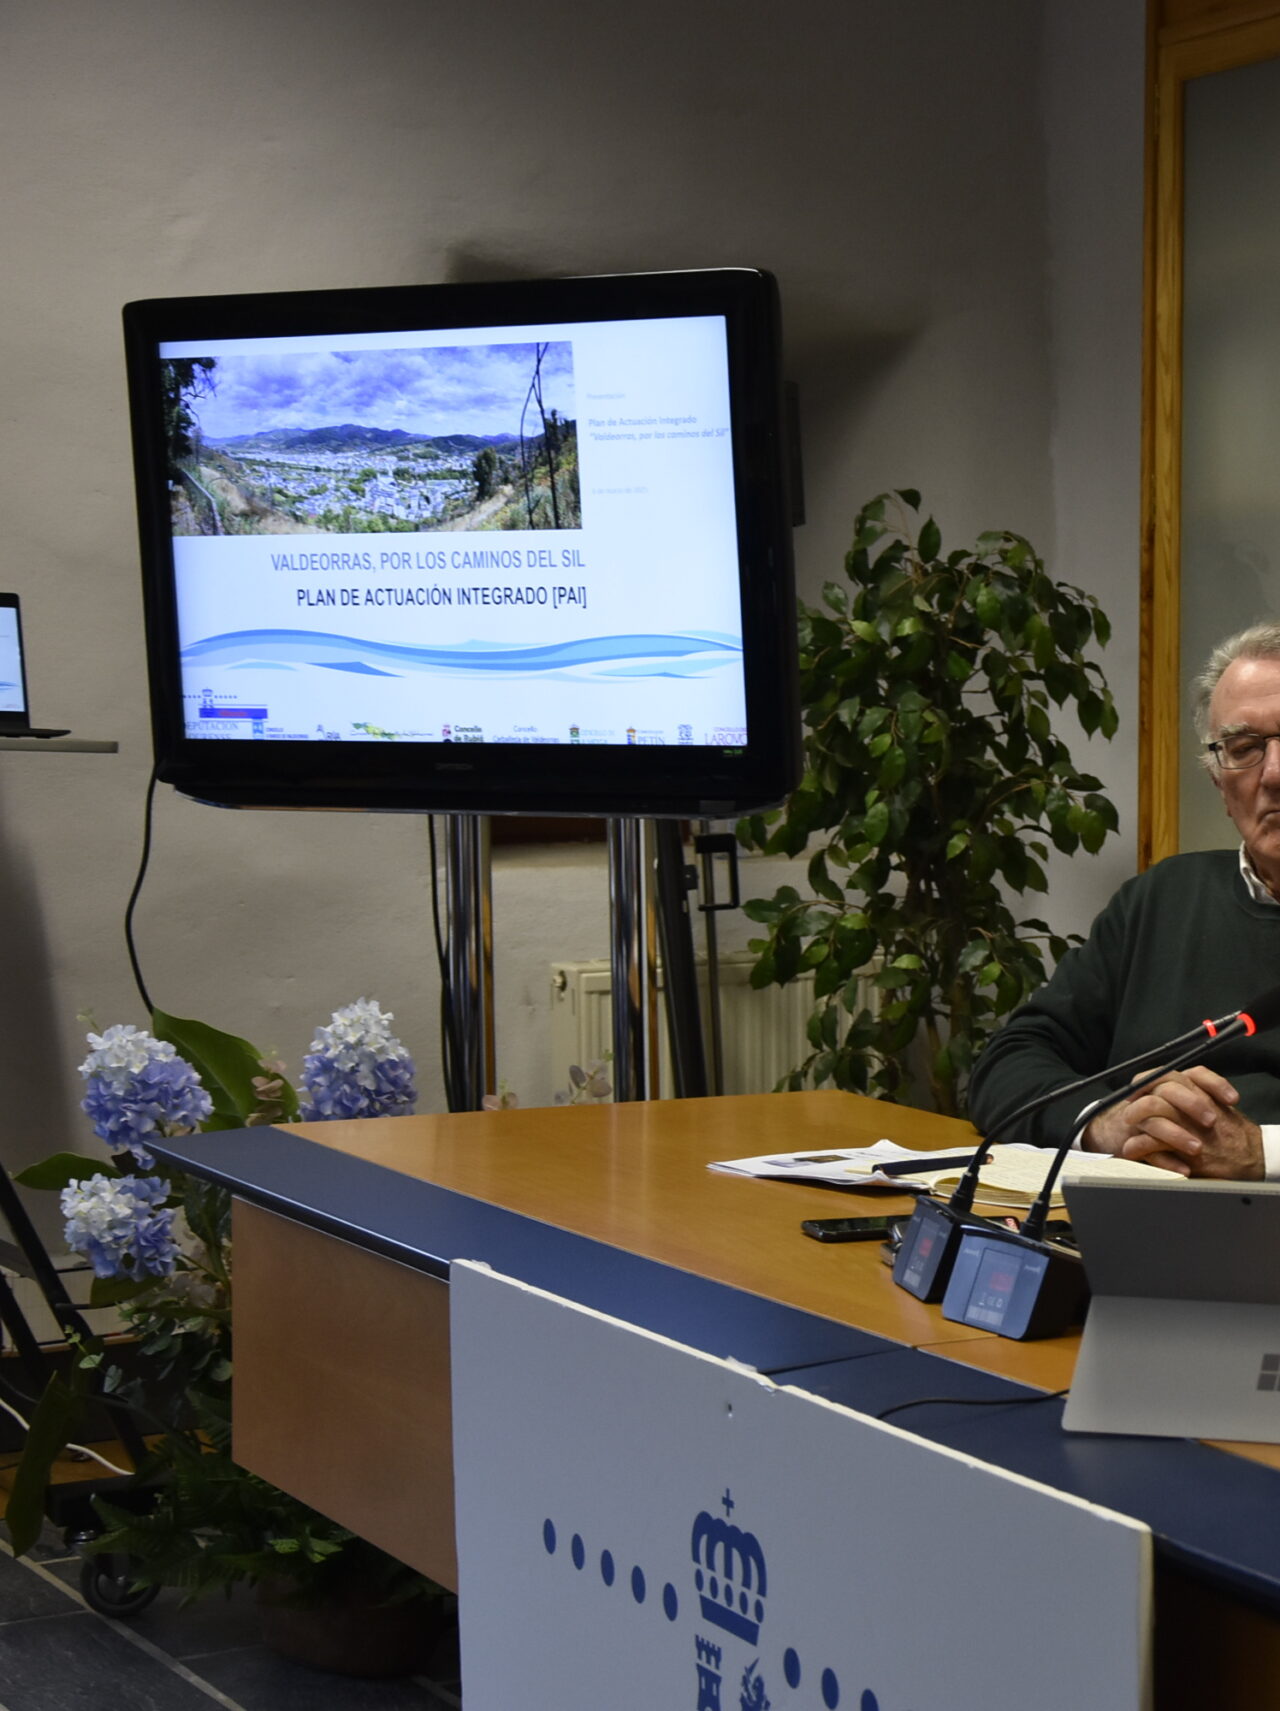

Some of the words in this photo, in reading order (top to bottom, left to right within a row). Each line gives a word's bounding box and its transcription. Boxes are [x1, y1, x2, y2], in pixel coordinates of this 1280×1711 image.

[588, 418, 605, 427] Plan
[607, 417, 617, 426] de
[659, 415, 697, 426] Integrado
[271, 552, 377, 573] VALDEORRAS,
[380, 552, 412, 570] POR
[416, 551, 447, 569] LOS
[451, 550, 522, 569] CAMINOS
[527, 549, 558, 568] DEL
[561, 549, 586, 567] SIL
[297, 588, 336, 606] PLAN
[340, 588, 360, 606] DE
[364, 583, 452, 606] ACTUACIÓN
[457, 586, 548, 605] INTEGRADO
[552, 585, 587, 609] [PAI]
